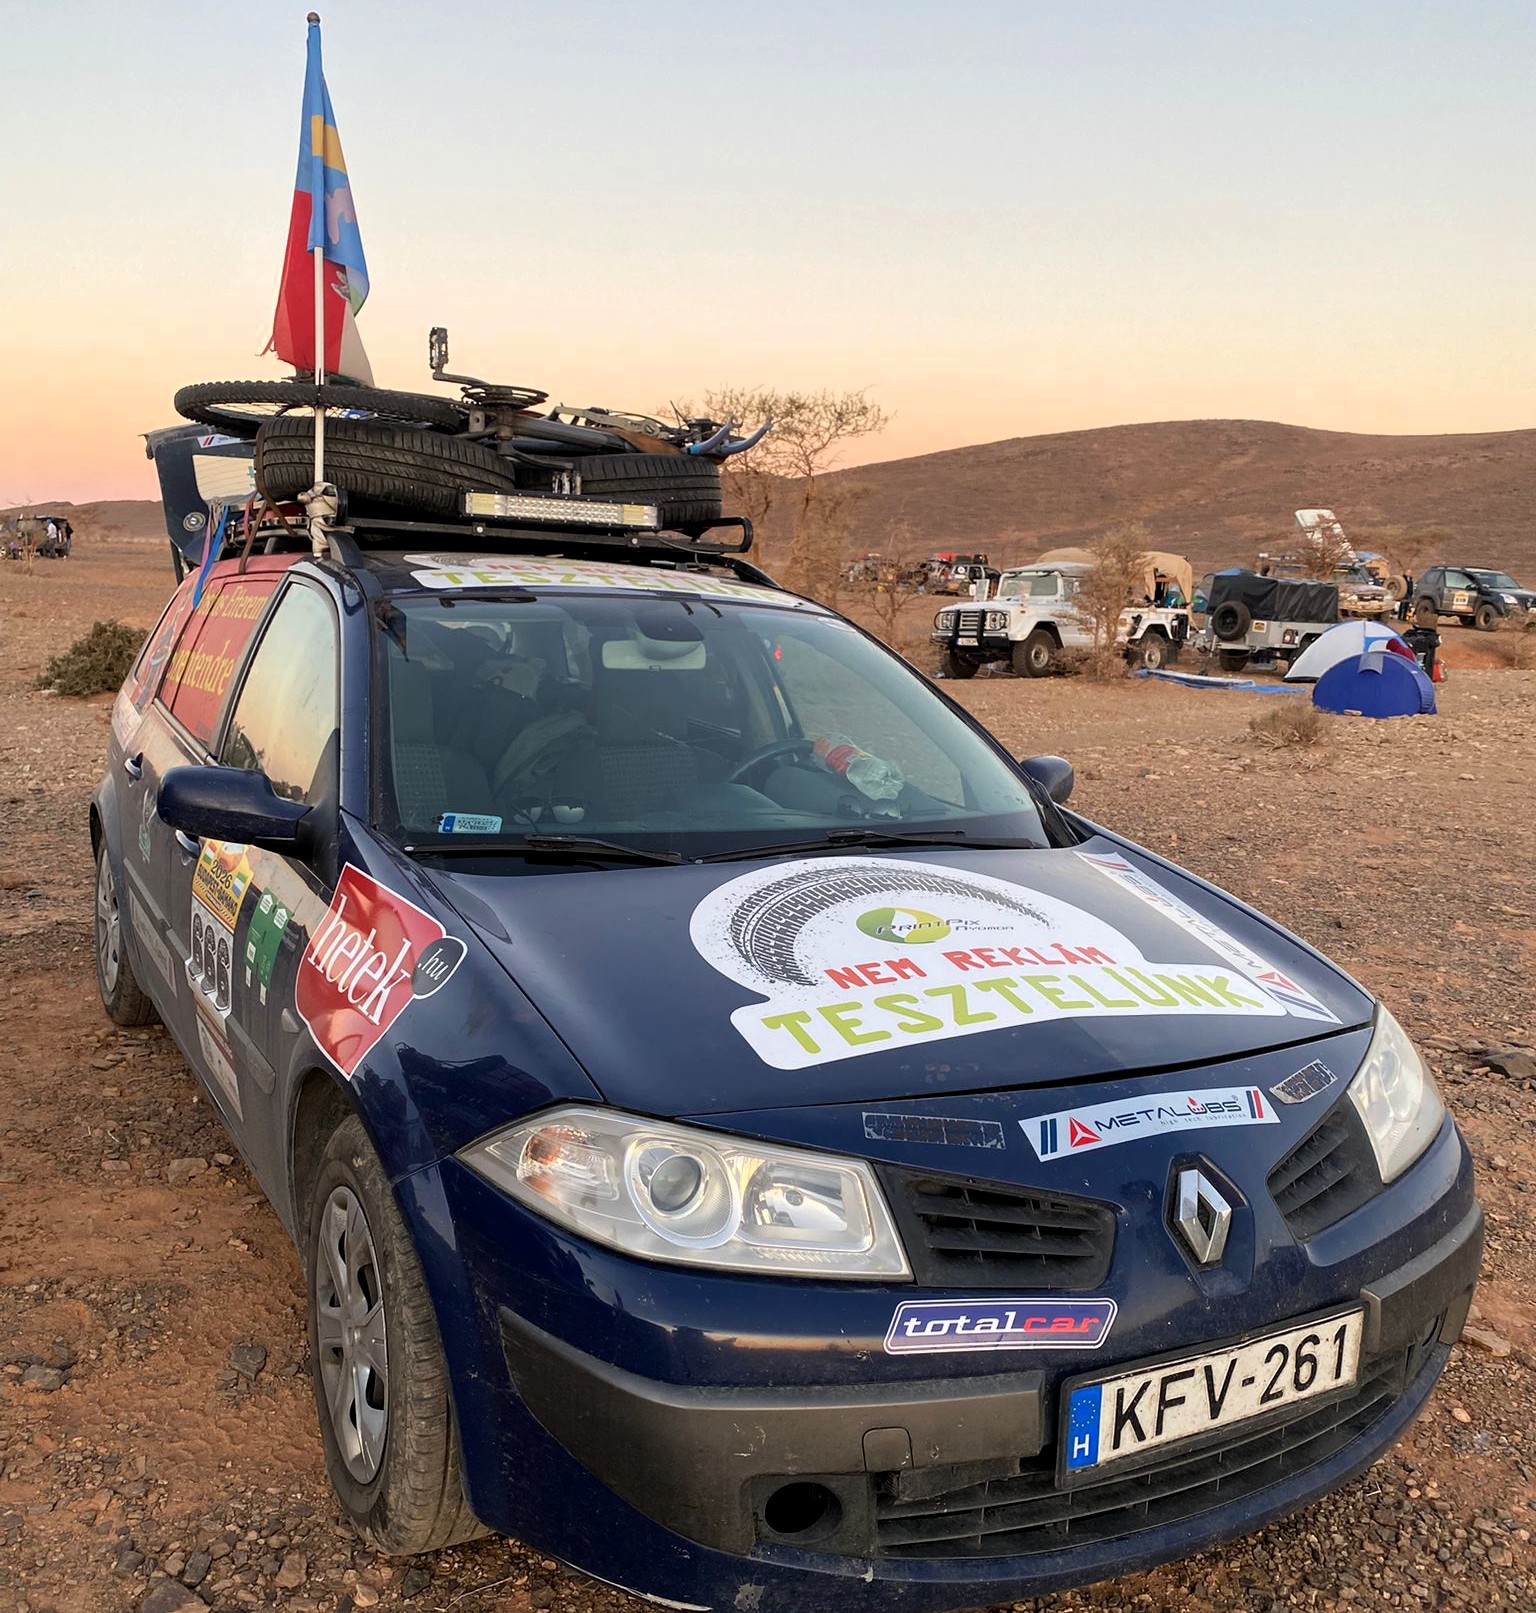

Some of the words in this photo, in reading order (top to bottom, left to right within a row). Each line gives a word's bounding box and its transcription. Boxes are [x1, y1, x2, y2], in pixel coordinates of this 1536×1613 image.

[210, 859, 233, 889] 2026
[307, 893, 412, 1026] hetek
[823, 957, 928, 990] NEM
[941, 943, 1118, 972] REKLÁM
[761, 966, 1265, 1055] TESZTELÜNK
[1160, 1117, 1180, 1126] high
[903, 1311, 1099, 1337] totalcar
[1072, 1433, 1090, 1459] H
[1112, 1324, 1348, 1451] KFV-261
